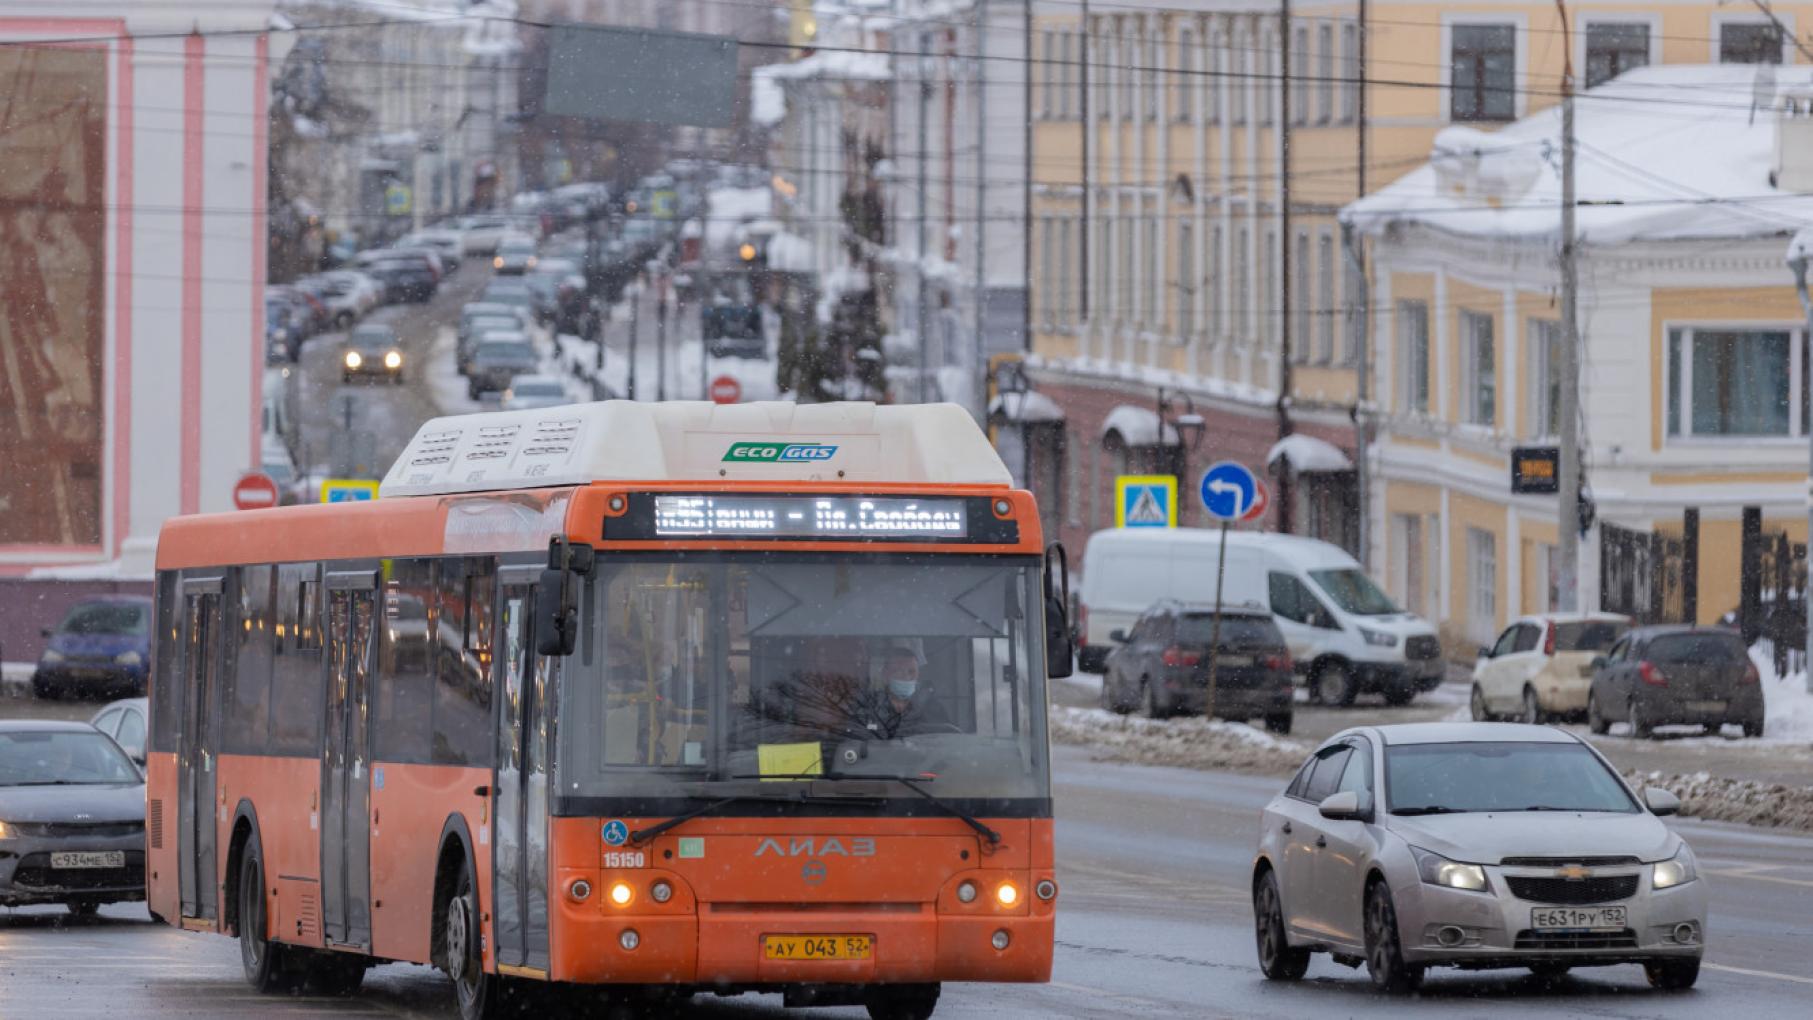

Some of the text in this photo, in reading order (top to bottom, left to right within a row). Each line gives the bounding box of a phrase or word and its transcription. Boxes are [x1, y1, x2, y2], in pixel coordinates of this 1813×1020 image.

[604, 852, 645, 868] 15150
[804, 939, 837, 956] 043
[846, 938, 864, 952] 52
